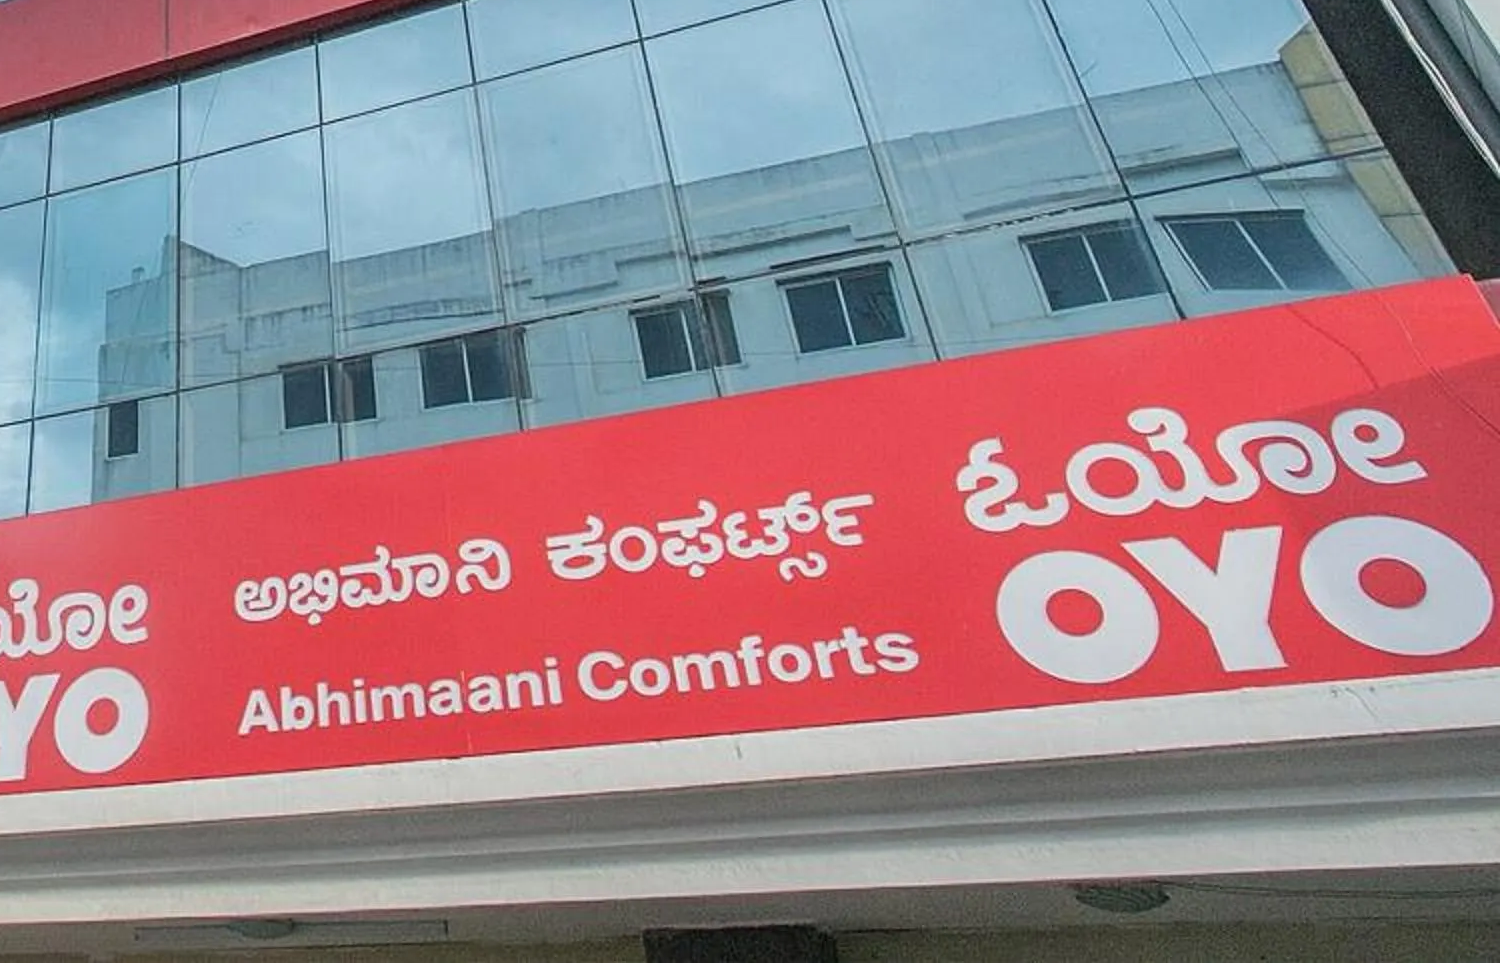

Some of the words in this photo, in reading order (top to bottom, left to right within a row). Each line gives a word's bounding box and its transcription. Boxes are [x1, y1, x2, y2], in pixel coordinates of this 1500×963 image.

[955, 406, 1429, 533] ಓಯೋ
[234, 537, 512, 625] ಅಭಿಮಾನಿ
[995, 514, 1495, 685] OYO
[237, 657, 563, 735] Abhimaani
[576, 626, 920, 701] Comforts
